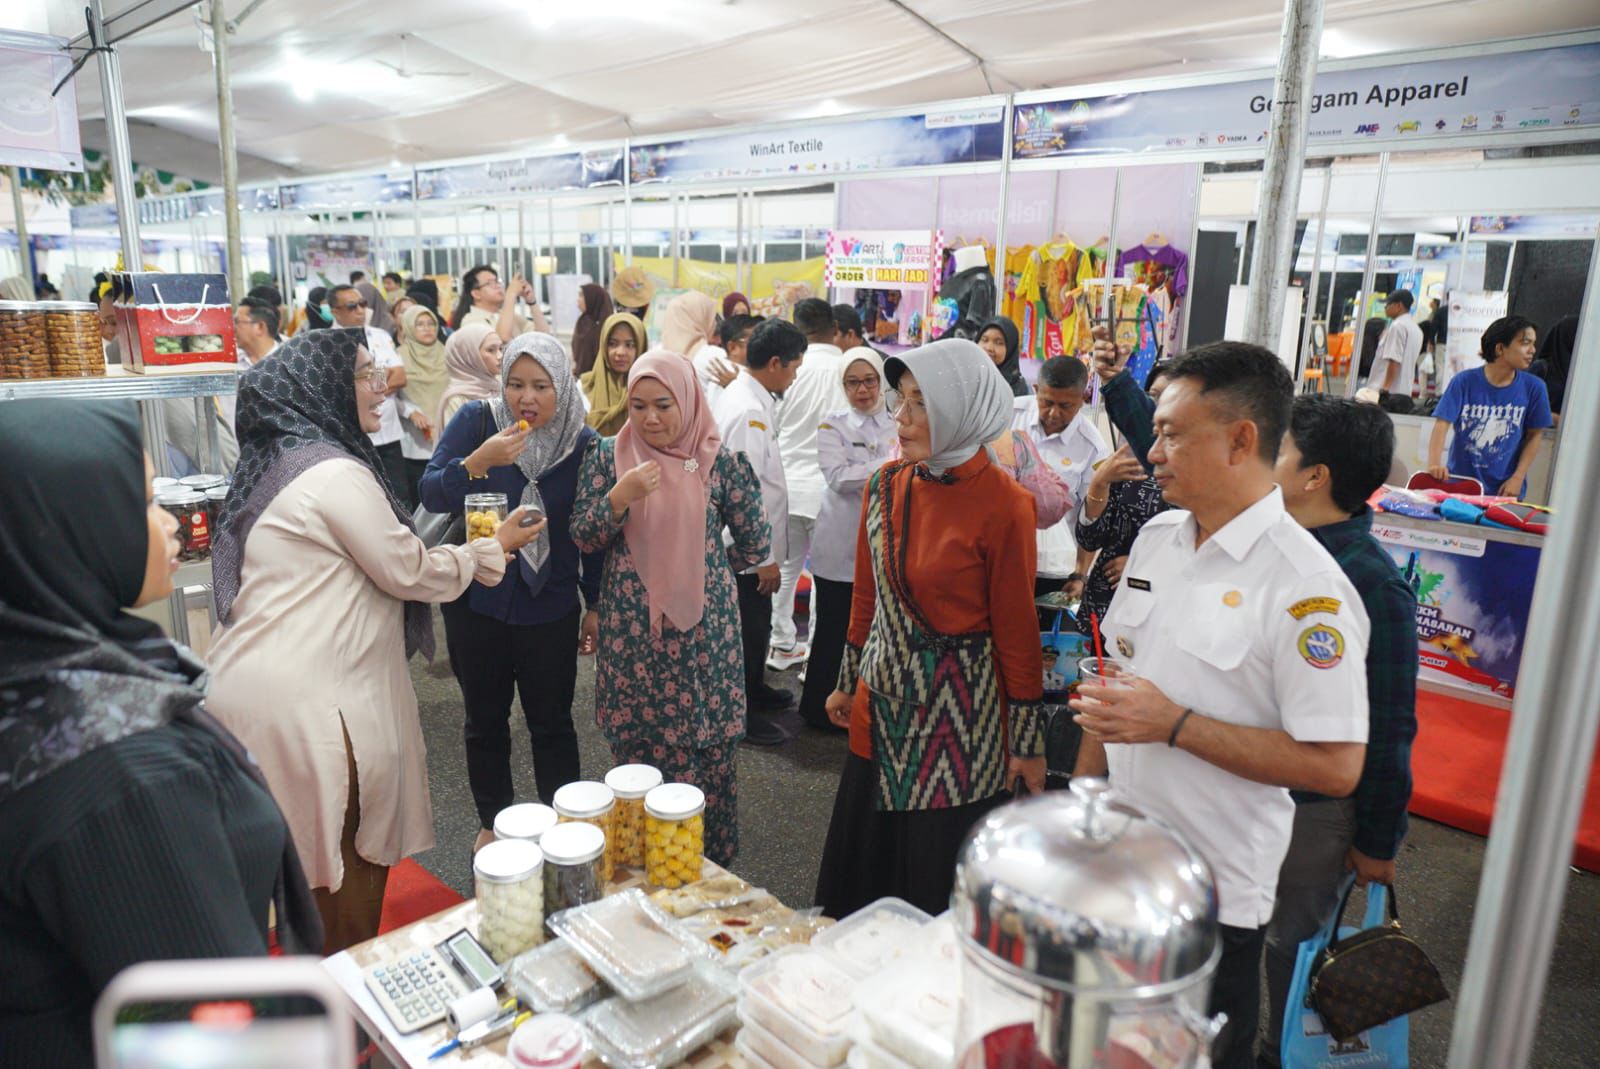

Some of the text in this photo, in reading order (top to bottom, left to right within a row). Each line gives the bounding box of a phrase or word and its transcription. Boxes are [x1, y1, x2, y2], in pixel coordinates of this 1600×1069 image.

[1250, 76, 1468, 114] Ggam Apparel
[750, 137, 823, 156] WinArt Textile
[835, 272, 864, 281] ORDER
[876, 268, 902, 282] HARI
[904, 269, 928, 283] JADI
[1461, 403, 1525, 426] empty
[1415, 615, 1472, 639] MASARAN
